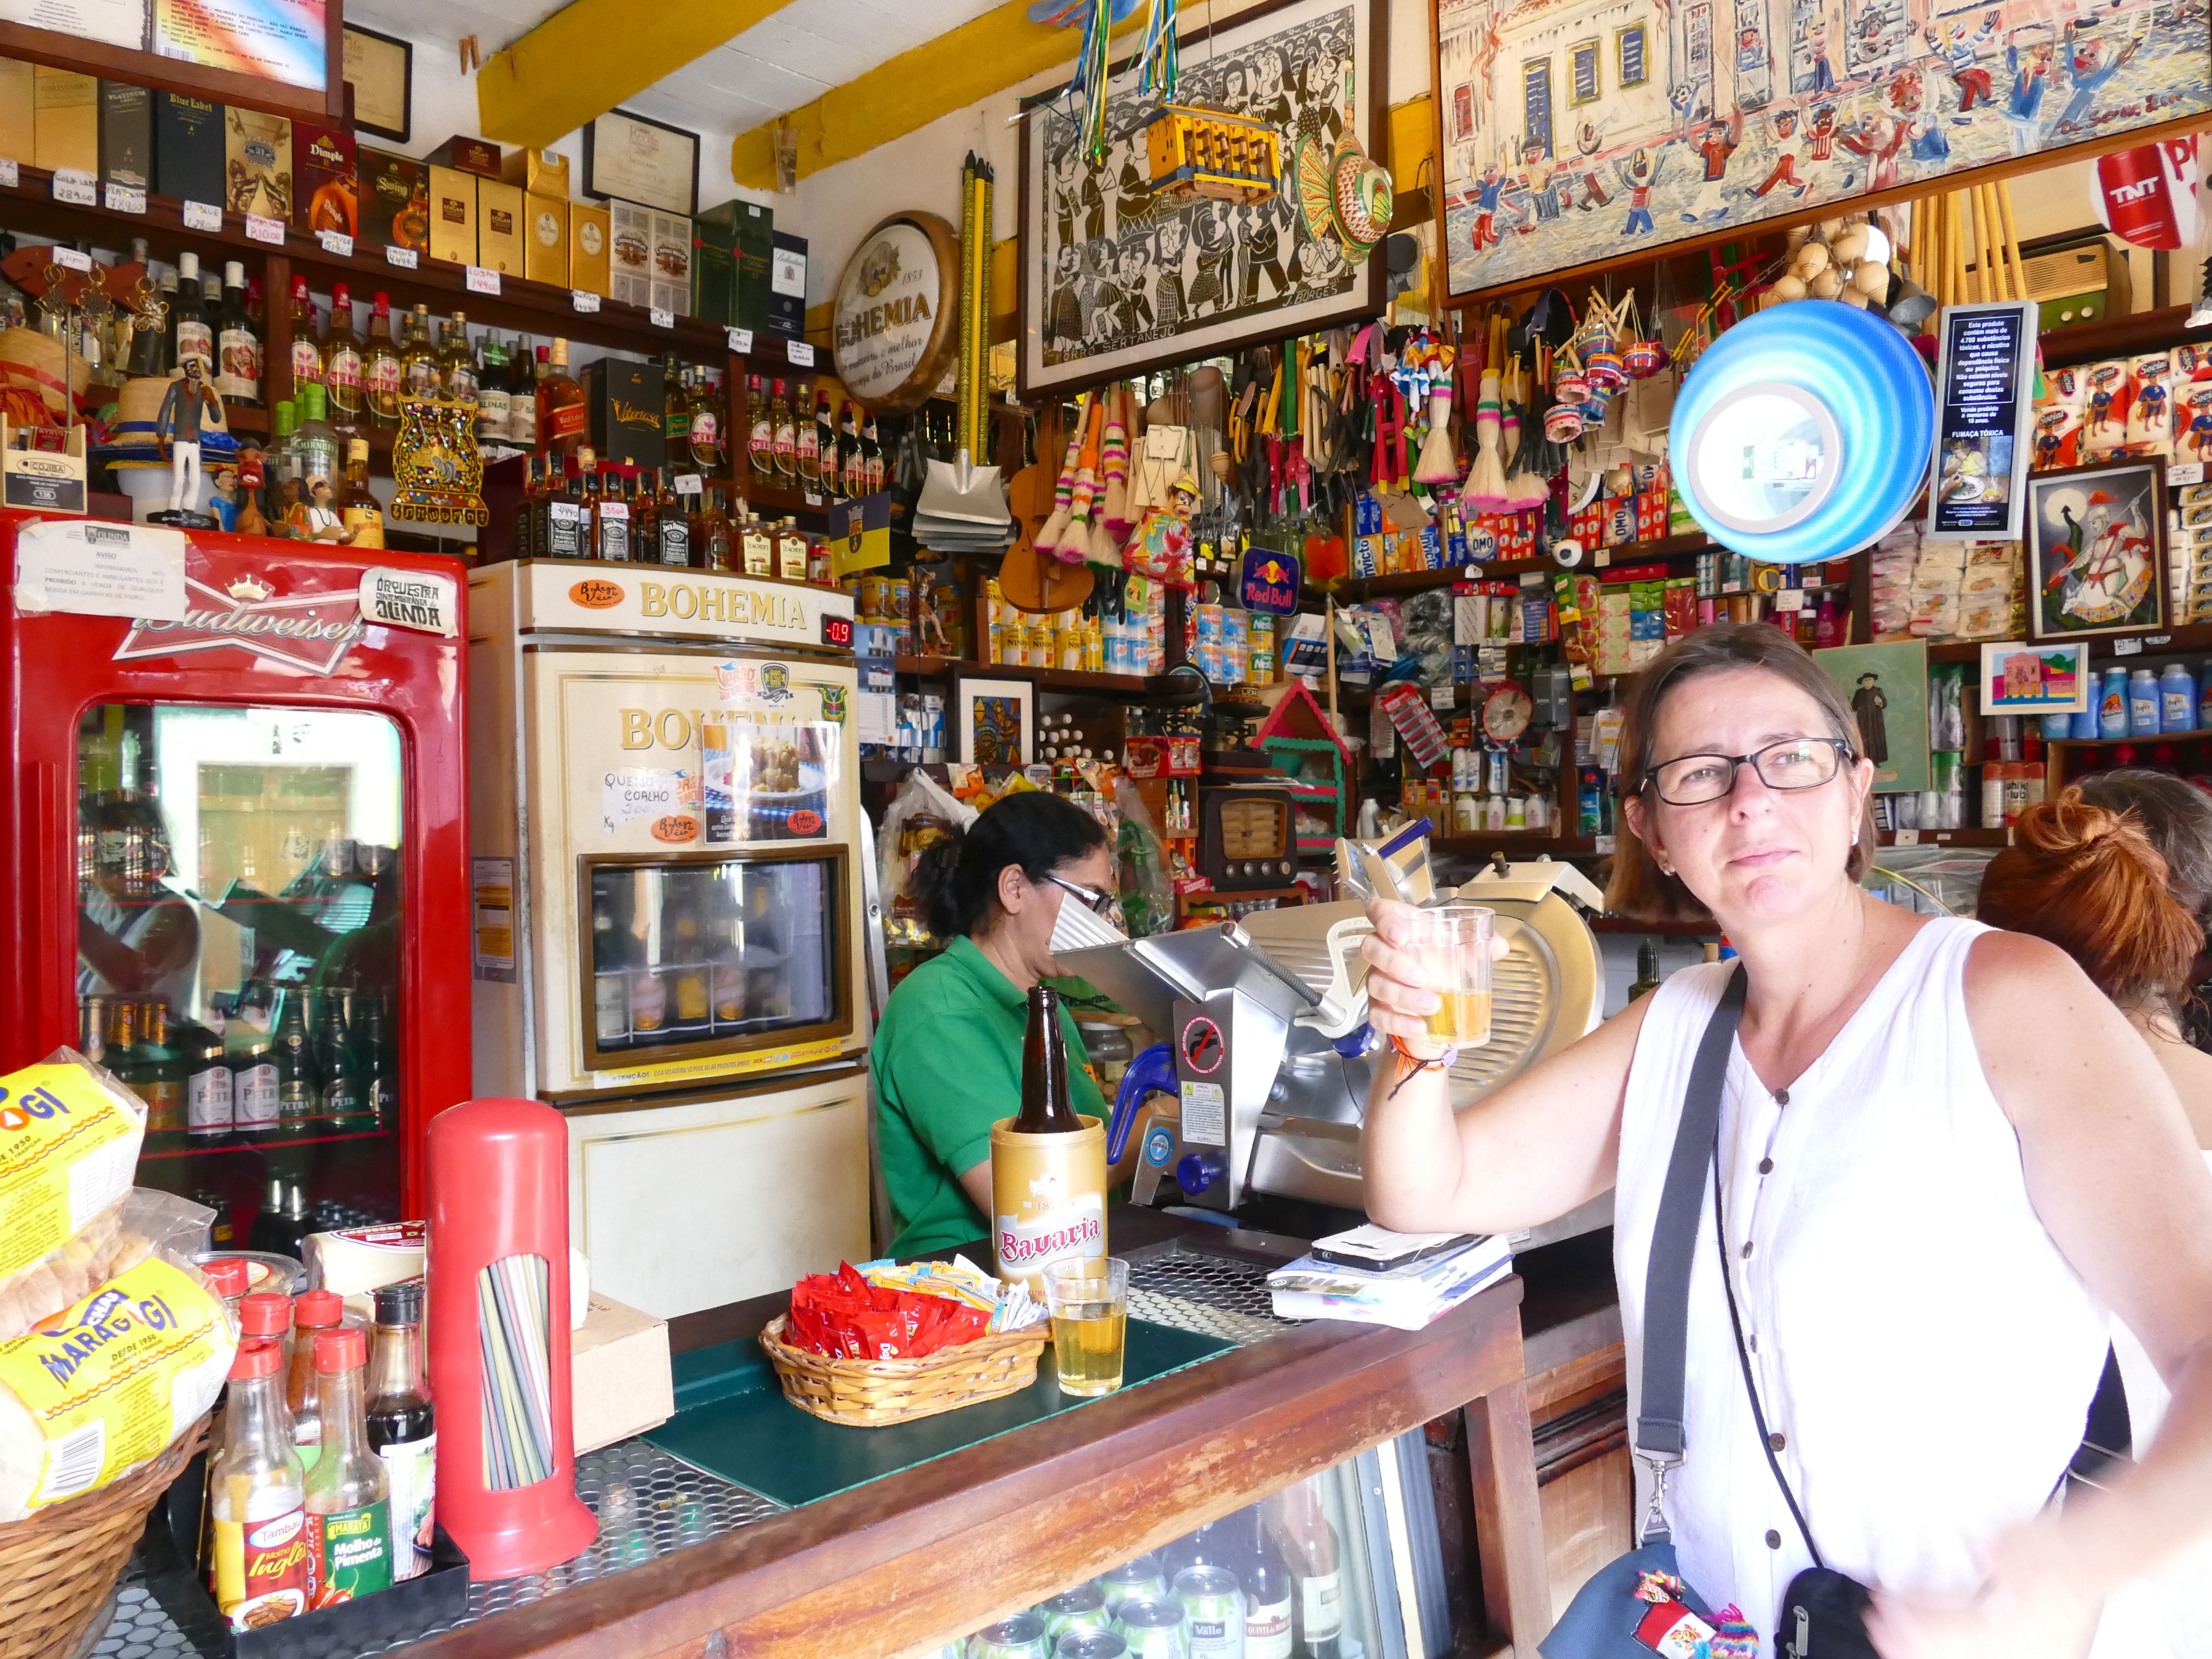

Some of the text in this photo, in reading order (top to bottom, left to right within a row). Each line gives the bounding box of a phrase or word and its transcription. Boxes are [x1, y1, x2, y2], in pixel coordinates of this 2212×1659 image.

[310, 144, 344, 162] Dimple
[377, 176, 408, 196] Swing
[2109, 176, 2159, 204] TNT
[492, 215, 511, 223] LOGAN
[1295, 287, 1338, 304] BORGES
[1982, 321, 2004, 329] produto
[1103, 326, 1176, 352] SERTANEJO
[1958, 358, 1993, 366] dependência
[2140, 360, 2168, 375] Social
[479, 402, 508, 410] ALINAS
[297, 441, 336, 454] SMIRNOFF
[32, 463, 63, 473] COJIBA
[1572, 493, 1578, 501] 5
[1615, 510, 1627, 536] OMO
[97, 530, 129, 542] OLINDA
[1473, 536, 1494, 551] OMO
[1359, 539, 1376, 577] nvicto
[1419, 532, 1438, 570] Invicto
[45, 568, 94, 578] COMERCIANTES
[102, 573, 143, 583] AMBULANTES
[95, 564, 138, 573] INFORMAMOS
[45, 577, 76, 585] PROIBIDO
[131, 585, 165, 594] QUALQUER
[80, 590, 112, 598] GARRAFAS
[377, 576, 439, 600] ORQUESTRA
[581, 582, 617, 595] Bodega
[1247, 584, 1293, 608] Red Bull
[639, 581, 807, 630] BOHEMIA
[825, 623, 848, 642] -0.9
[624, 790, 669, 802] COALHO
[659, 816, 693, 830] Bodega
[612, 1061, 736, 1082] ATENÇÃO! ESTA GELADEIRA SÓ PODE GELAR PRODUTOS
[8, 1135, 31, 1155] 1950
[1037, 1201, 1065, 1211] 1877
[1000, 1217, 1101, 1262] Bavaria
[111, 1333, 157, 1362] DESDE 1950
[266, 1547, 291, 1560] Molho
[334, 1536, 382, 1556] Molho de
[249, 1540, 307, 1580] Inglês
[335, 1546, 383, 1571] Pimenta
[1248, 1626, 1269, 1635] QUINTA
